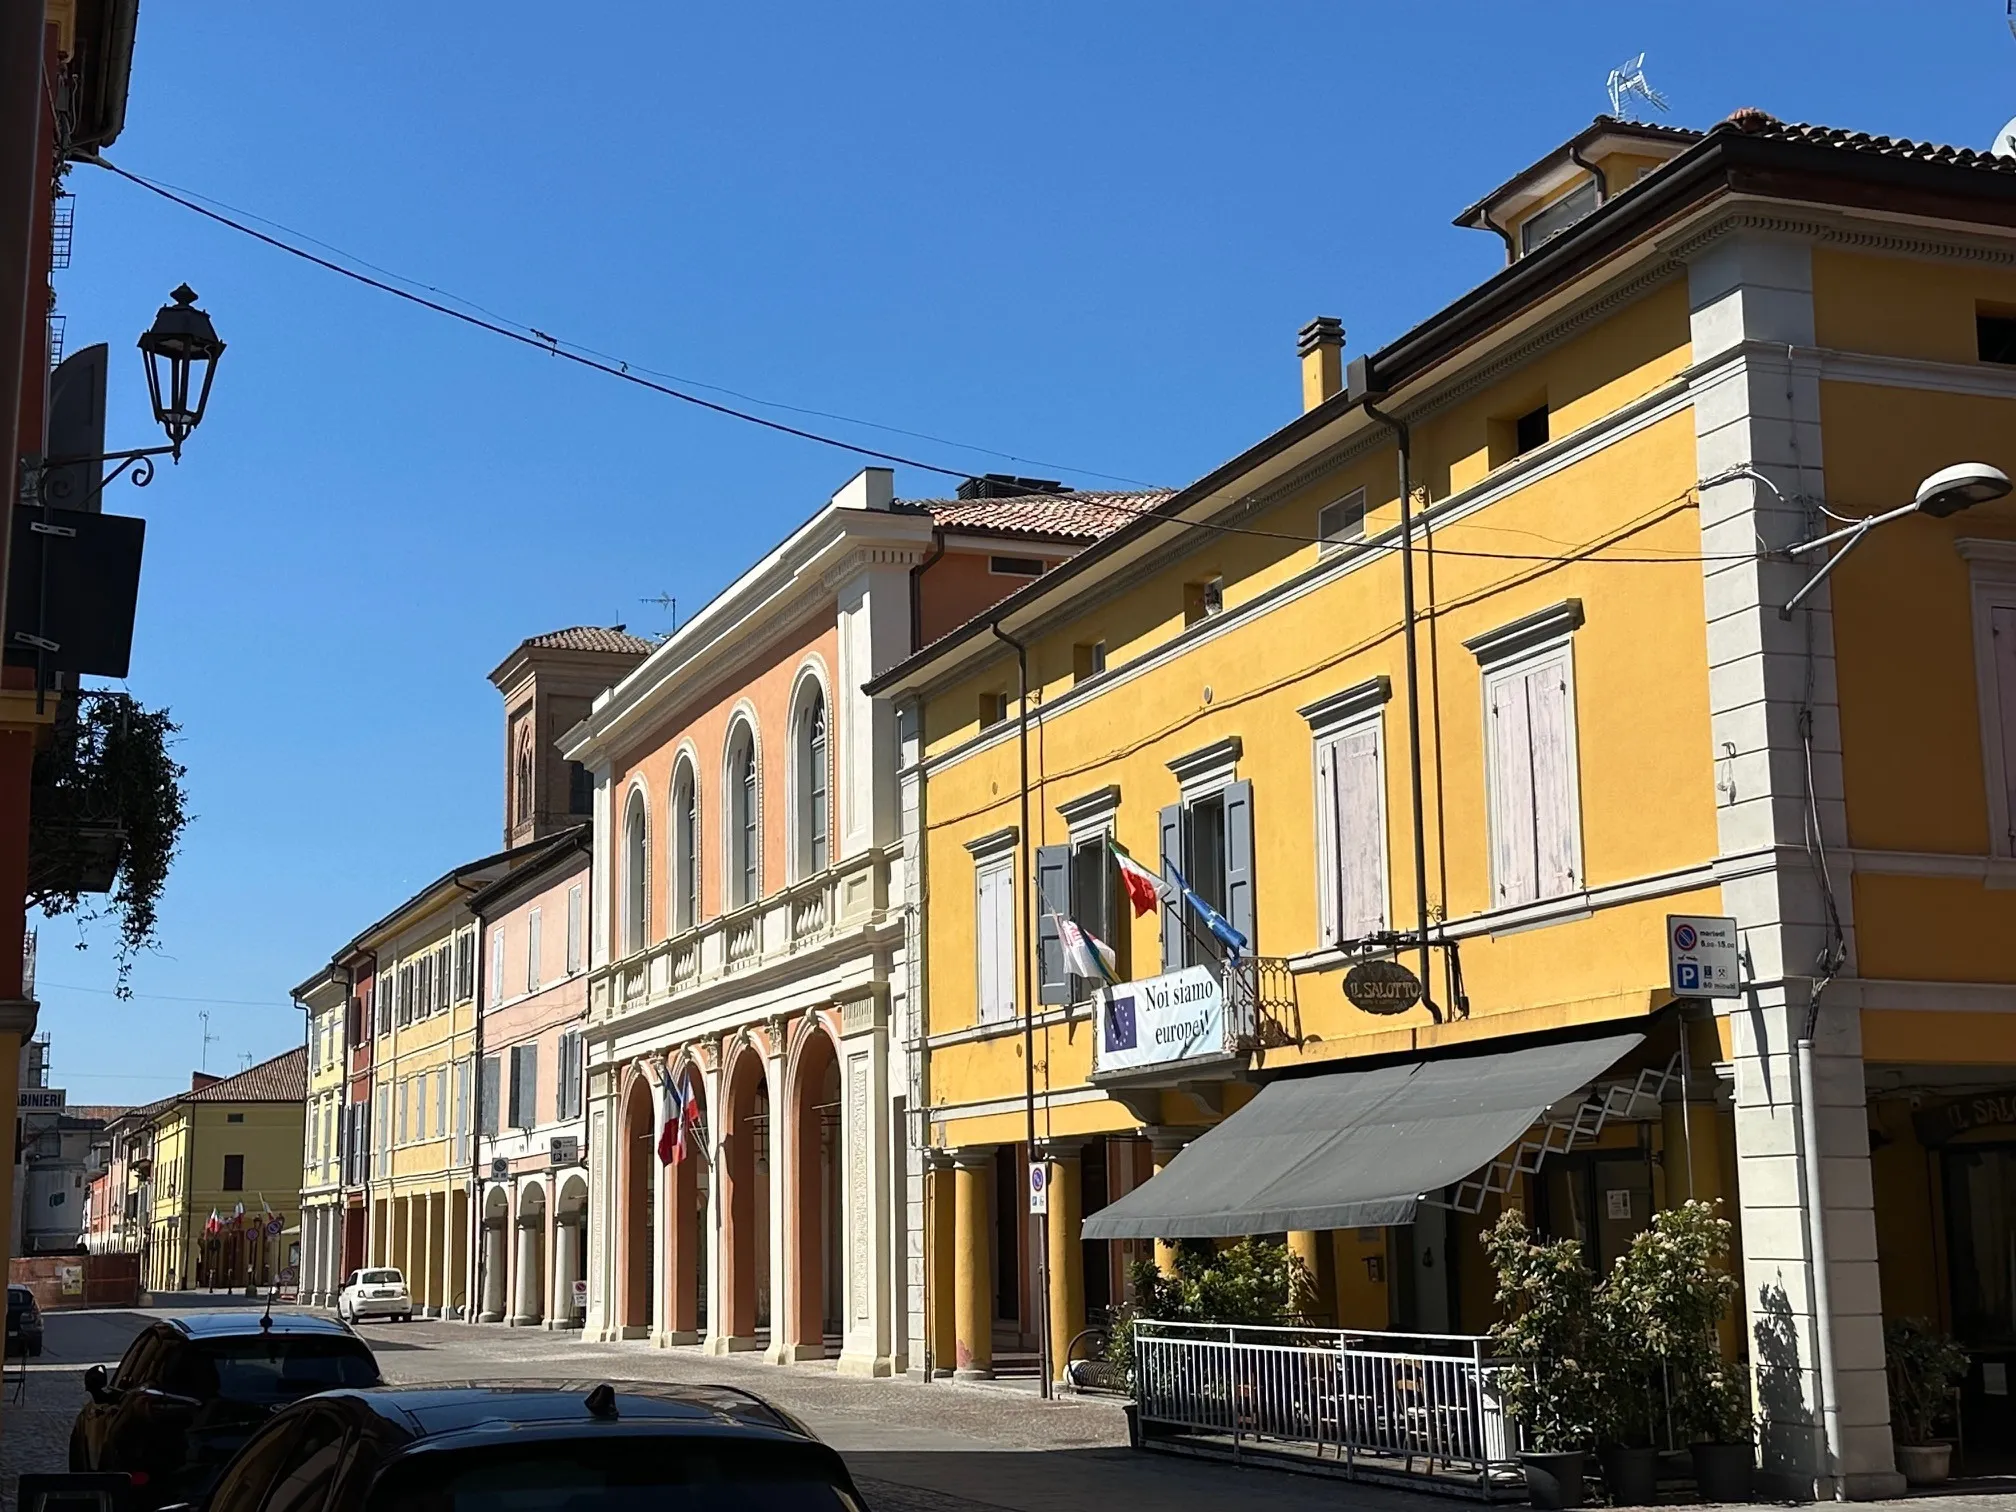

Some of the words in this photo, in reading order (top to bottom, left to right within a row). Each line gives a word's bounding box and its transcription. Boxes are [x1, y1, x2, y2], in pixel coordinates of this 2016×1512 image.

[1363, 981, 1419, 998] SALOTTO
[1682, 966, 1695, 986] P
[1145, 982, 1170, 1012] Noi
[1173, 978, 1213, 1005] siamo
[1155, 1009, 1210, 1048] europei!
